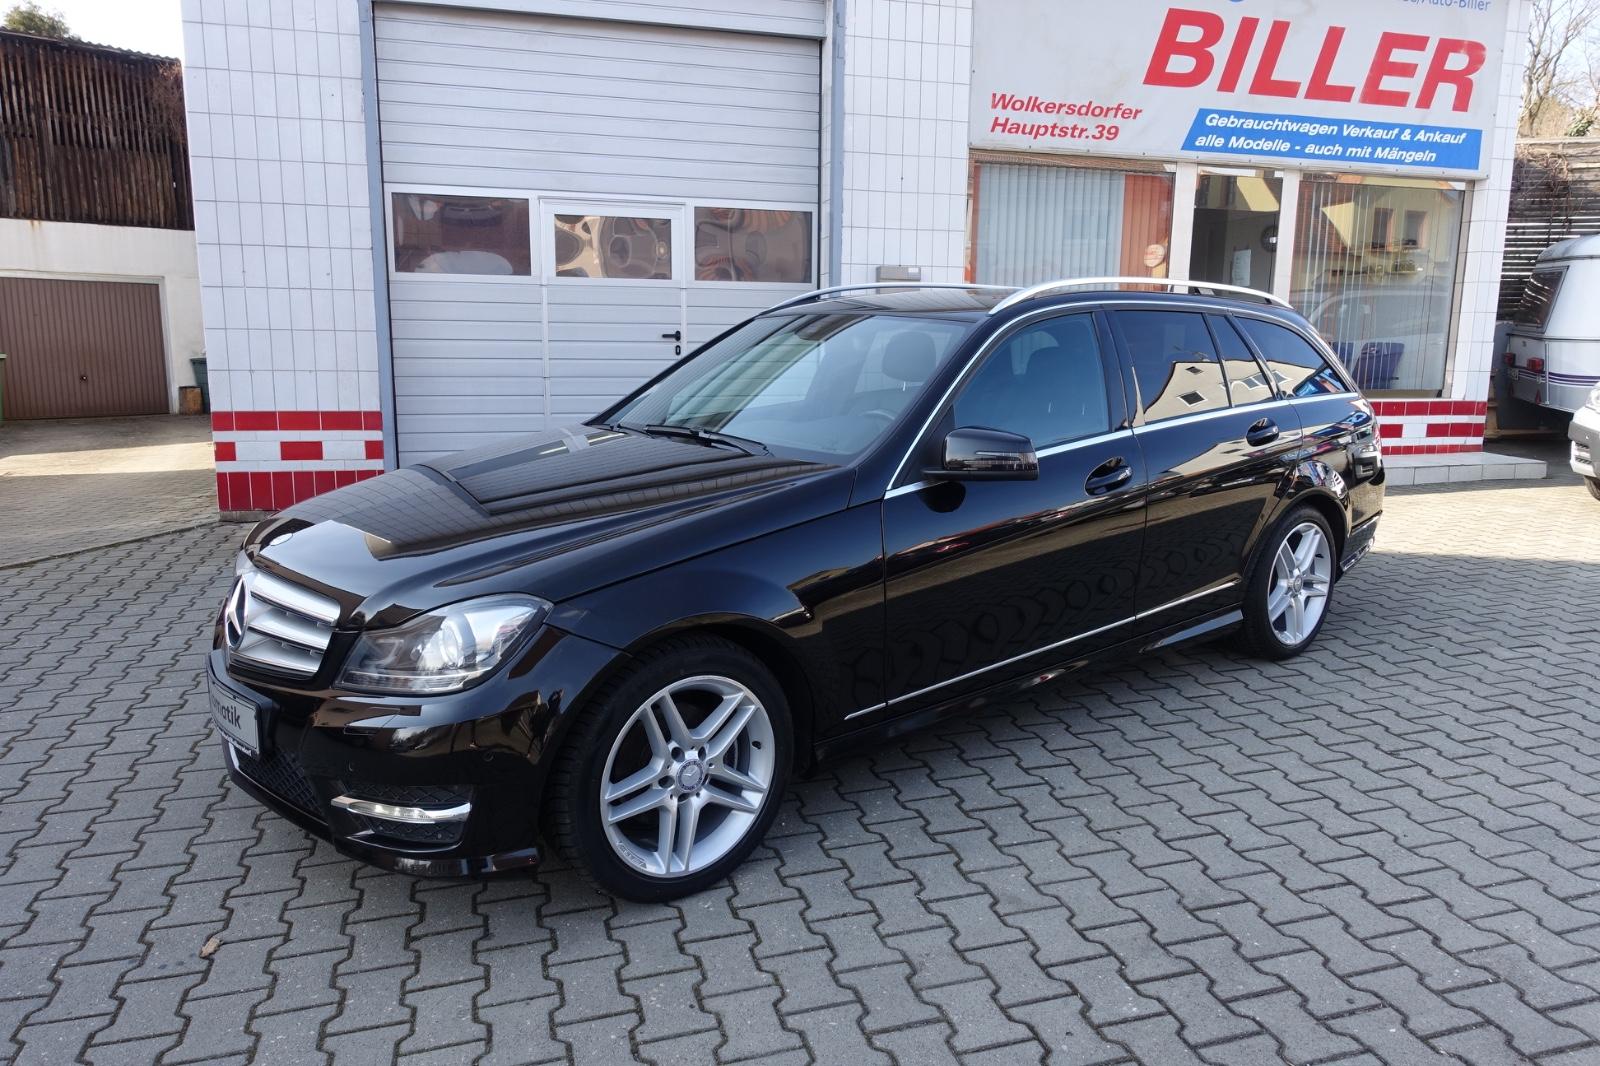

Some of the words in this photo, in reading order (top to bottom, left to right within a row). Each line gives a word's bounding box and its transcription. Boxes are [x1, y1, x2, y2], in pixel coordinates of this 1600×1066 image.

[1142, 8, 1487, 112] BILLER
[990, 92, 1143, 120] Wolkersdorfer
[990, 116, 1120, 141] Hauptstr.39
[1205, 113, 1338, 136] Gebrauchtwagen
[1342, 124, 1400, 140] Verkauf
[1400, 128, 1411, 141] &
[1413, 129, 1467, 144] Ankauf
[1194, 134, 1225, 147] alle
[1228, 136, 1291, 152] Modelle
[1304, 143, 1343, 156] auch
[1345, 145, 1372, 159] mit
[1374, 146, 1437, 163] Mängeln
